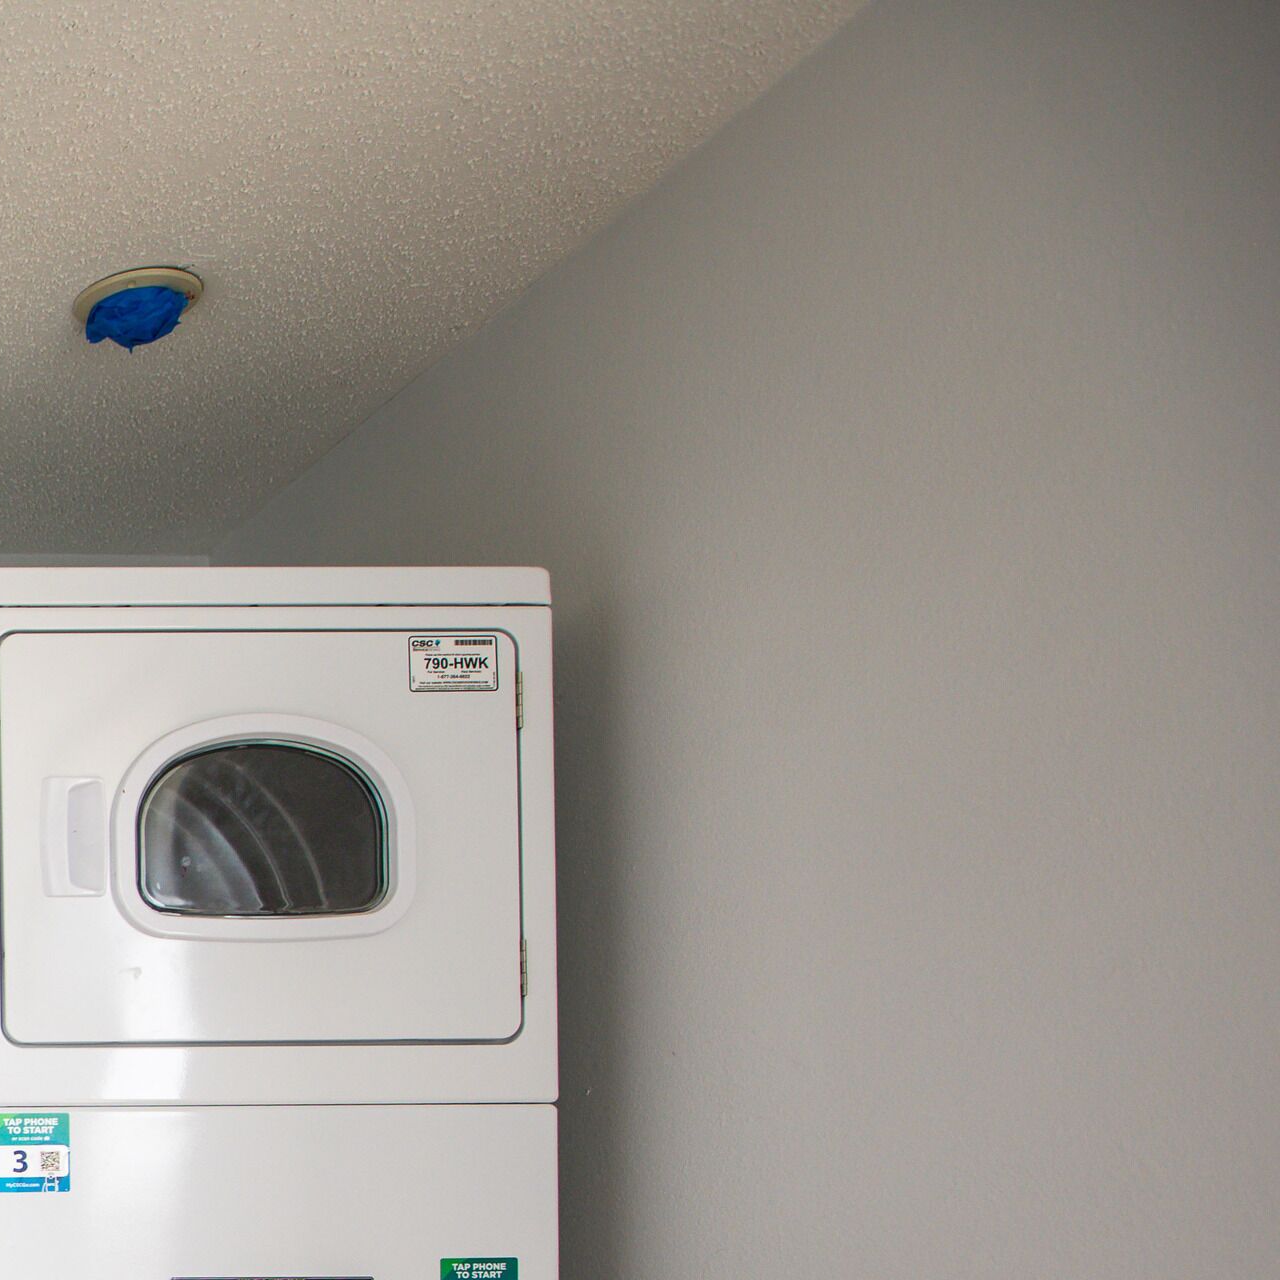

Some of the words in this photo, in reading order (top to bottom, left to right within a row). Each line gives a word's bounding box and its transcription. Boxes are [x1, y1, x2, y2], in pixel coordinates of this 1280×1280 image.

[424, 657, 489, 669] 790-HWK
[3, 1118, 22, 1126] TAP
[24, 1118, 59, 1126] PHONE
[7, 1126, 21, 1134] TO
[23, 1126, 54, 1134] START
[13, 1150, 28, 1173] 3
[452, 1263, 471, 1271] TAP
[456, 1271, 470, 1279] TO
[471, 1271, 503, 1279] START
